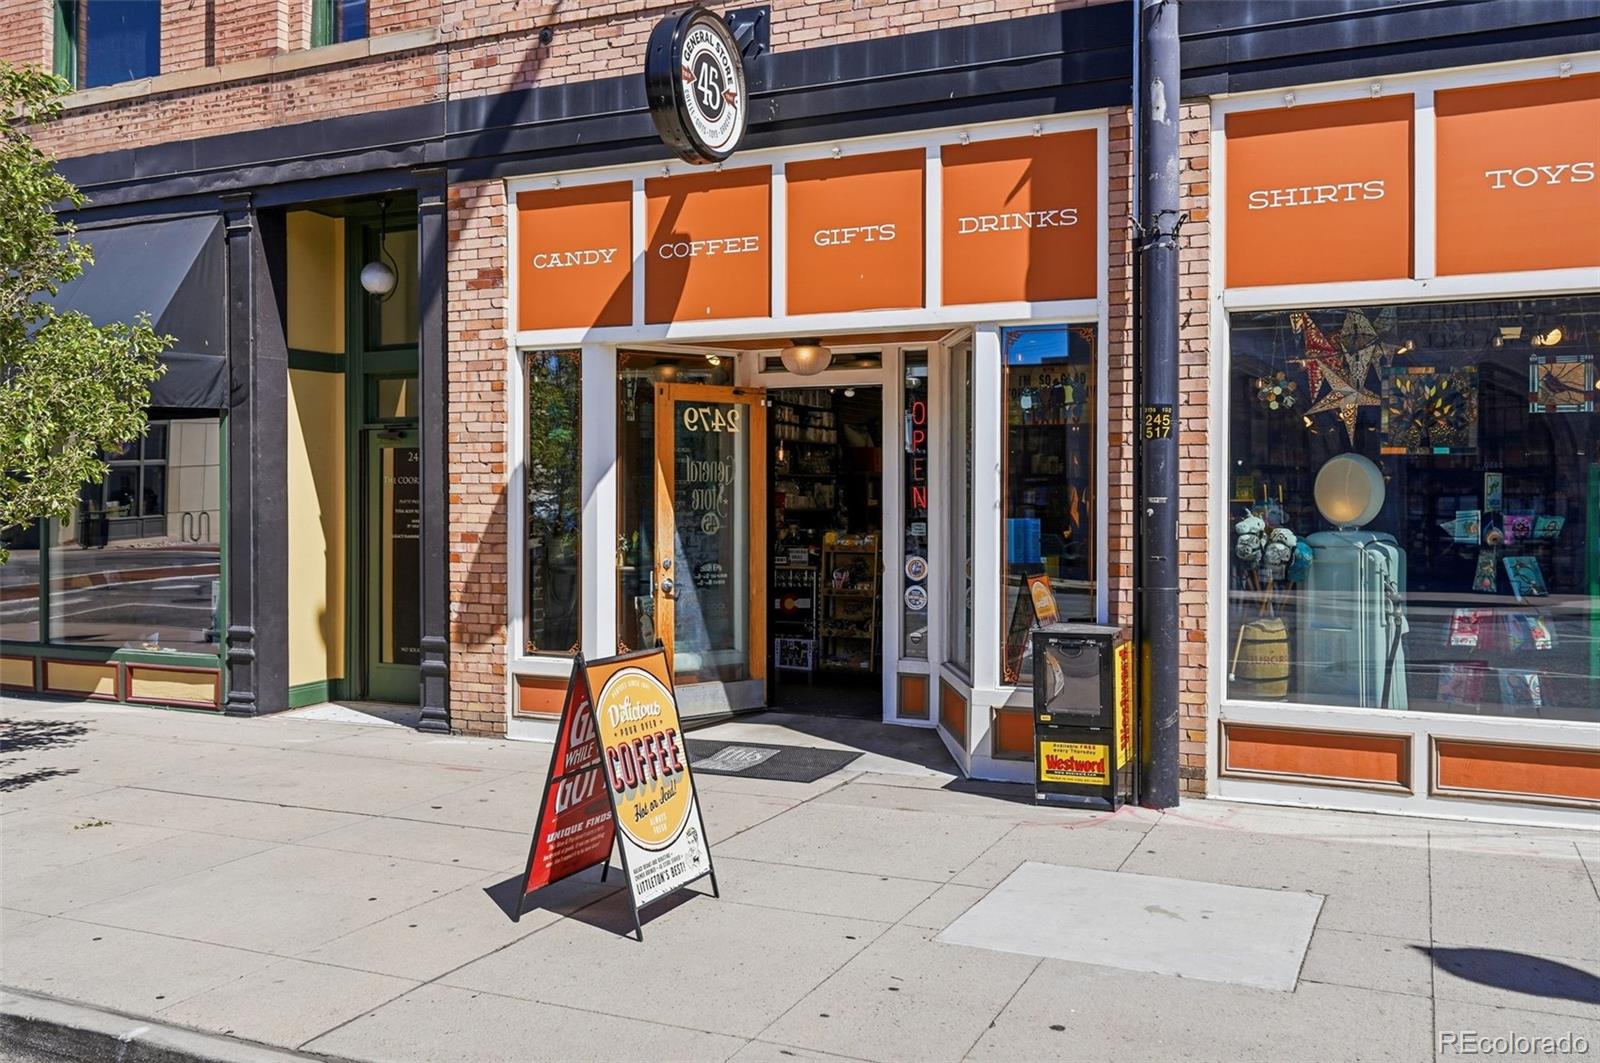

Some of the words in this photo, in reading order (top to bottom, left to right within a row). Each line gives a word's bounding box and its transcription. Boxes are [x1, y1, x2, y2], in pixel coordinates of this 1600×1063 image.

[684, 31, 714, 62] GENERAL
[715, 42, 733, 85] STORE
[697, 61, 720, 110] 45
[1485, 162, 1595, 190] TOYS
[1248, 180, 1385, 210] SHIRTS
[814, 224, 896, 246] GIFTS
[958, 208, 1078, 234] DRINKS
[533, 248, 617, 269] CANDY
[658, 236, 759, 259] COFFEE
[1145, 414, 1170, 426] 245
[1145, 427, 1170, 438] 517
[911, 401, 927, 509] OPEN
[608, 696, 662, 728] Delicious
[620, 725, 637, 737] POUR
[641, 719, 657, 733] OVER
[565, 741, 594, 769] WHILE
[605, 727, 684, 793] COFFEE
[1045, 754, 1105, 773] Westword
[634, 803, 649, 822] Hot
[650, 801, 658, 812] or
[658, 783, 677, 808] Iced!
[546, 822, 583, 843] UNIQUE
[585, 811, 612, 828] FINDS
[636, 869, 671, 895] LITTLETON'S
[671, 861, 687, 882] BEST!
